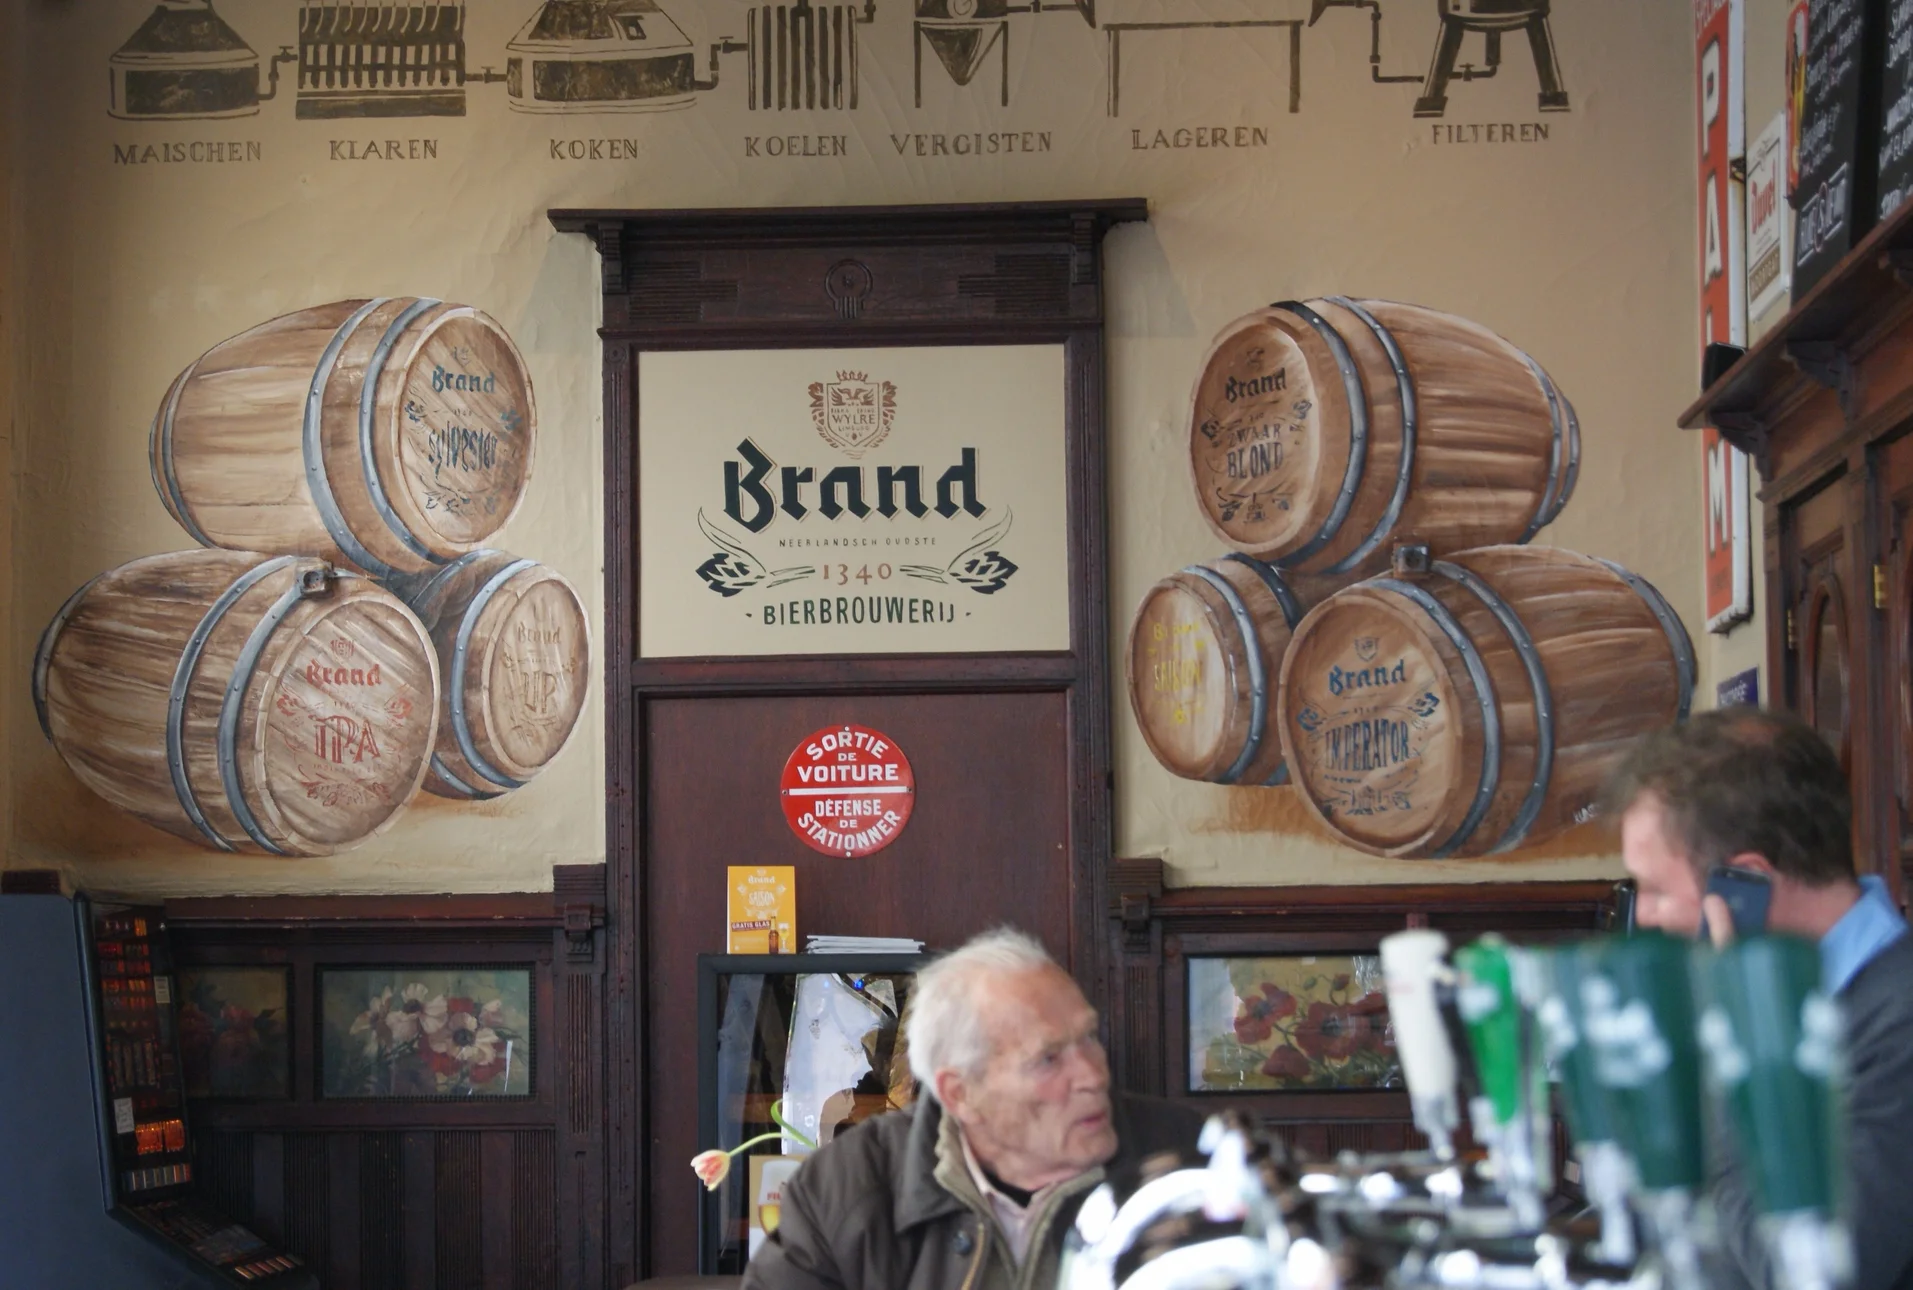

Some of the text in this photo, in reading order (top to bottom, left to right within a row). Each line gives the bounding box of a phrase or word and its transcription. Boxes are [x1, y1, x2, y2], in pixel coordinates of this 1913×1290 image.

[744, 135, 848, 157] KOELEN
[889, 131, 1052, 156] VERGISTEN
[1131, 126, 1269, 150] LAGEREN
[1432, 123, 1550, 145] FILTEREN
[113, 141, 262, 166] MAISCHEN
[329, 139, 438, 160] KLAREN
[550, 138, 639, 160] KOKEN
[432, 365, 496, 394] Brand
[1225, 367, 1288, 403] Brand
[832, 414, 876, 425] WYLRE
[1228, 424, 1282, 448] ZWAAR
[1227, 442, 1285, 480] BLOND
[723, 437, 989, 534] Brand
[779, 537, 937, 548] NEERLANDSCH OUDSTE
[823, 562, 893, 586] 1340
[763, 596, 955, 625] BIERBROUWERIJ
[306, 658, 382, 690] Brand
[1328, 658, 1407, 697] Brand
[309, 714, 382, 764] IPA
[806, 731, 889, 761] SORTIE
[1325, 718, 1410, 772] IMPERATOR
[838, 752, 857, 762] DE
[797, 763, 899, 783] VOITURE
[815, 798, 882, 817] DÉFENSE
[797, 810, 901, 850] STATIONNER
[839, 819, 857, 829] DE
[732, 920, 771, 930] GRATIS GLAS
